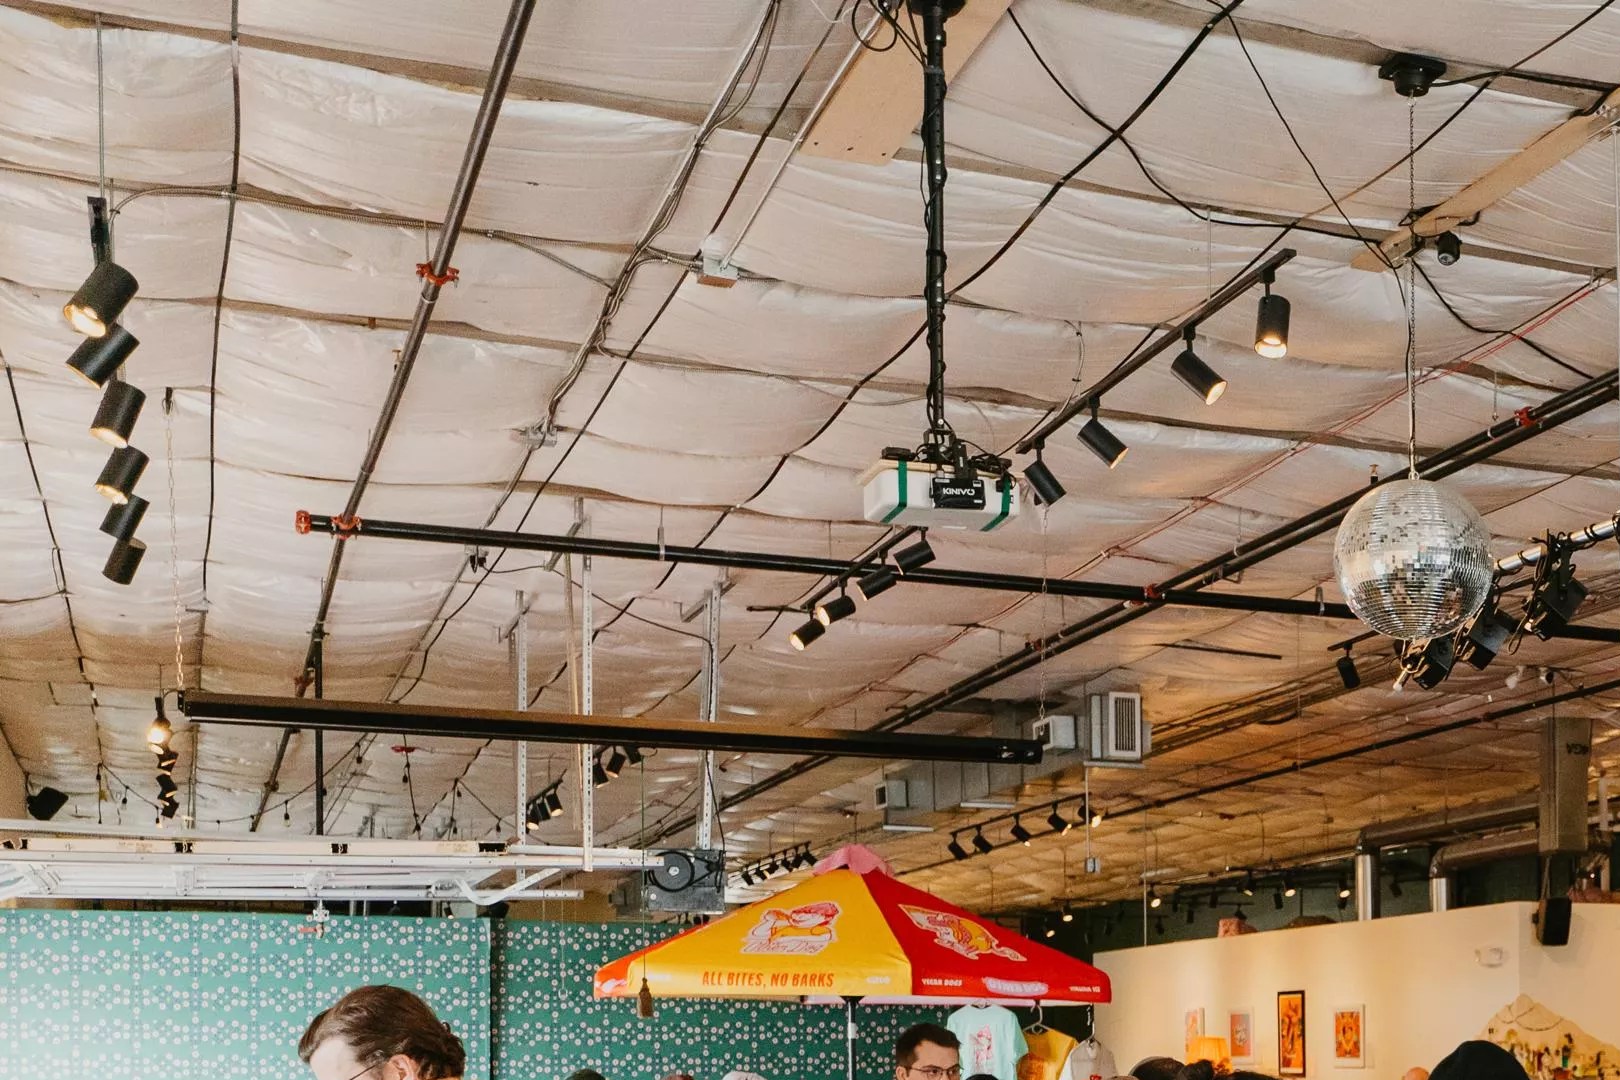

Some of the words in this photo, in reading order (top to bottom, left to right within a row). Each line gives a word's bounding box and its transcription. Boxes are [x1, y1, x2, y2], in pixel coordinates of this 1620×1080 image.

[943, 487, 975, 496] KINIVO
[702, 971, 723, 986] ALL
[726, 972, 766, 988] BITES,
[771, 972, 788, 986] NO
[792, 972, 834, 987] BARKS
